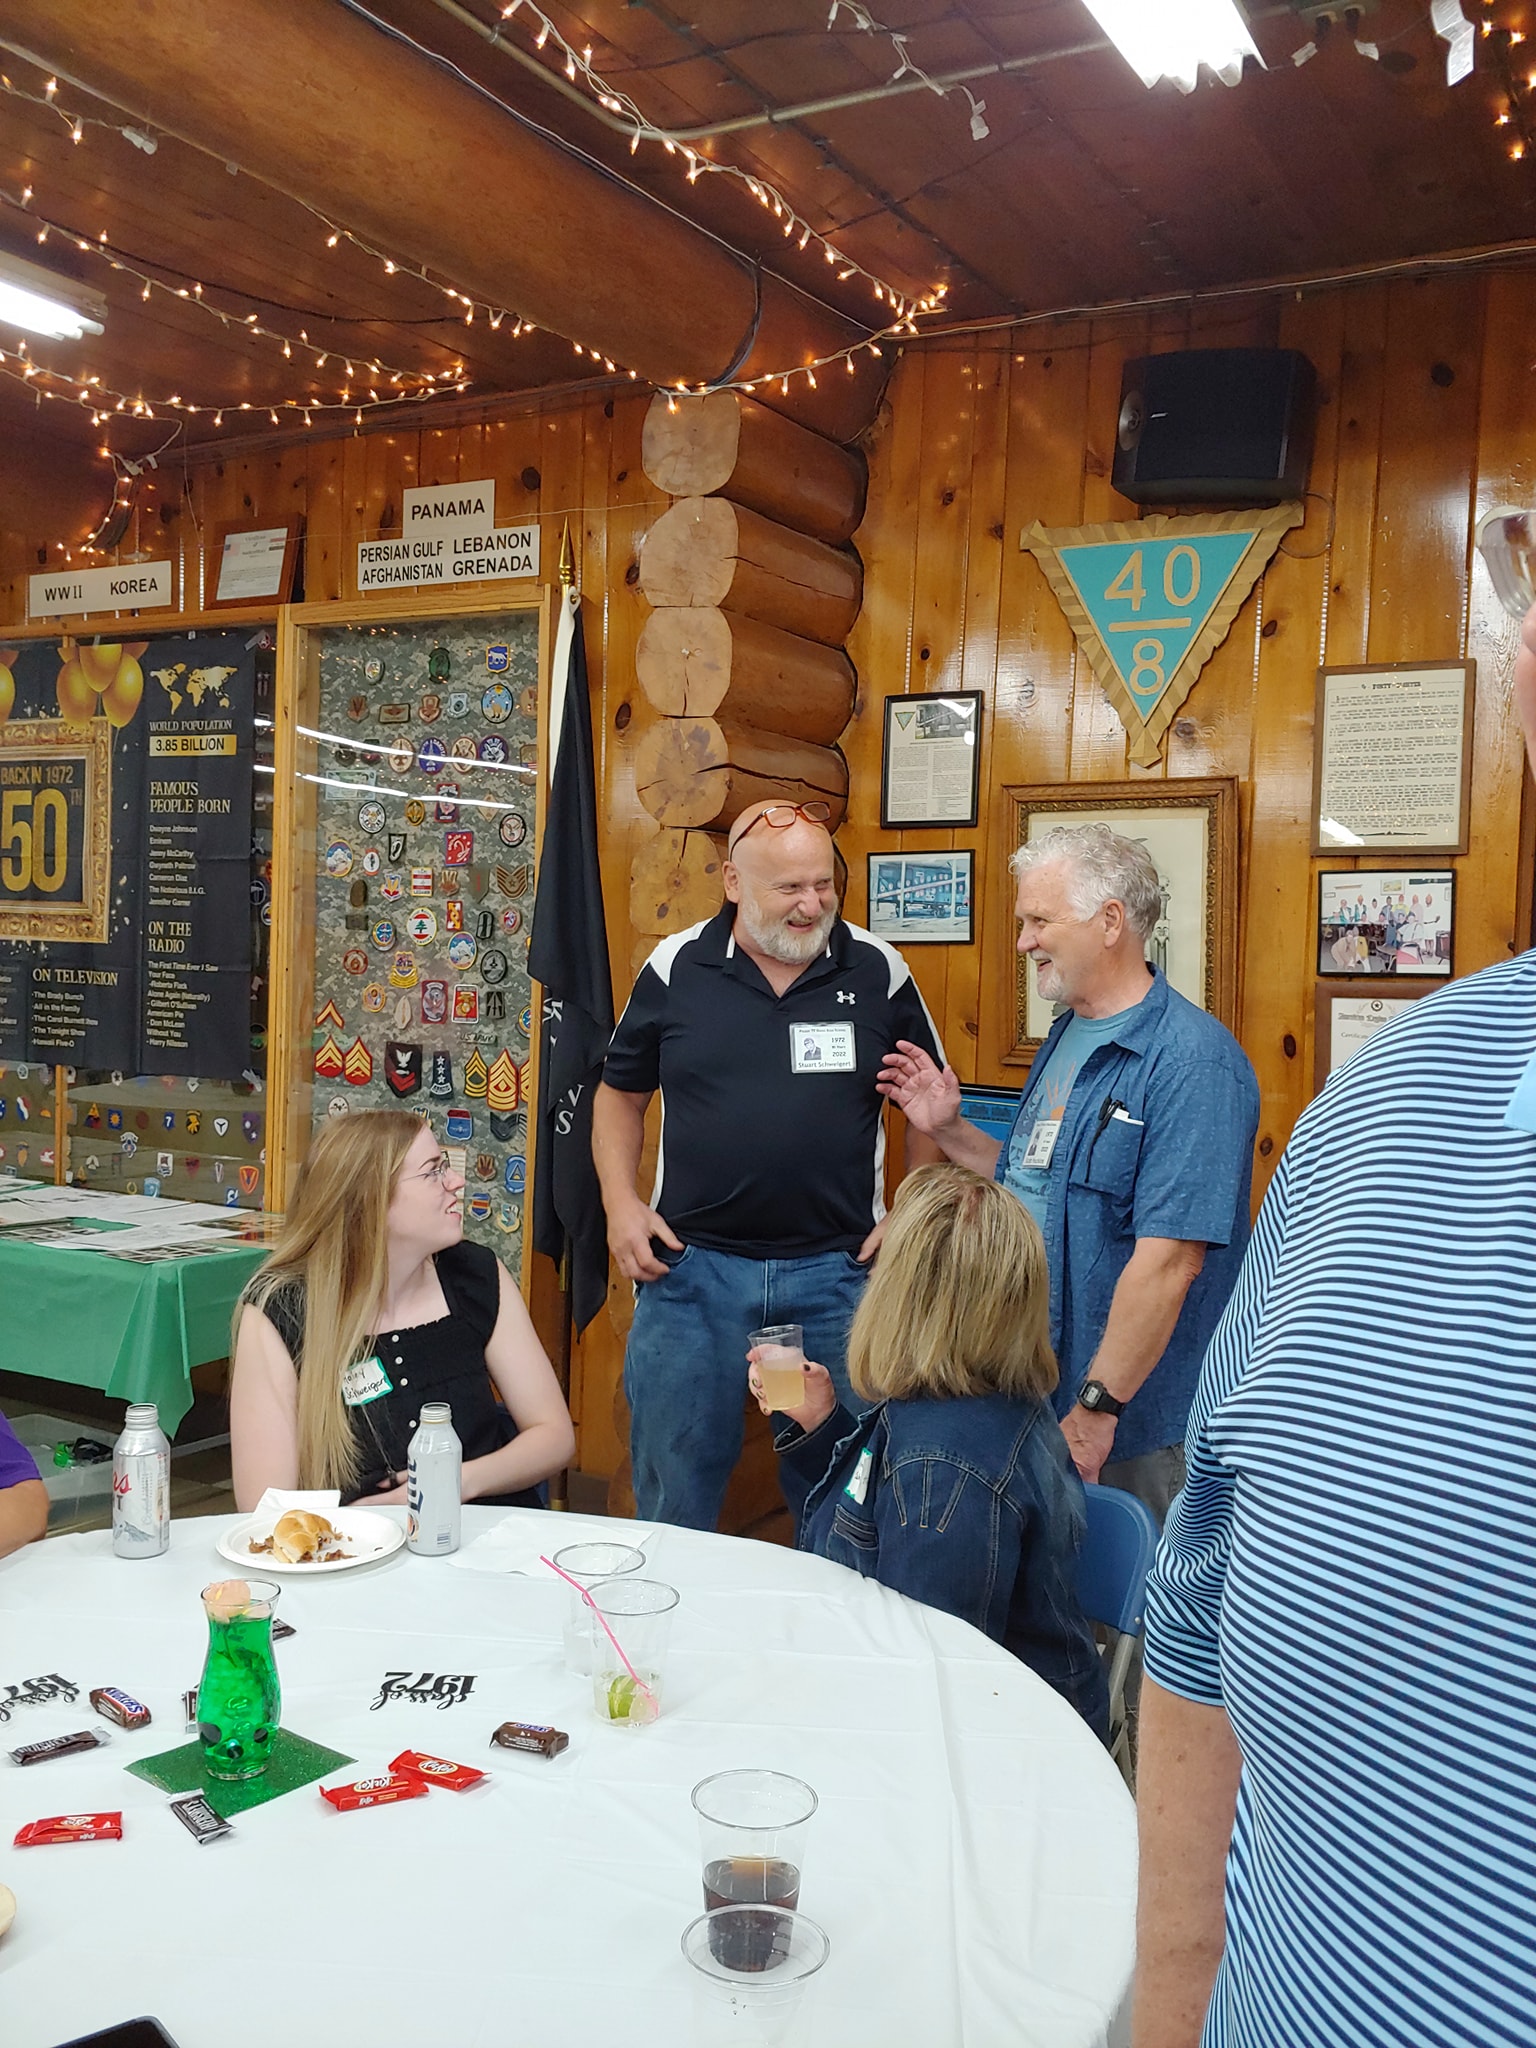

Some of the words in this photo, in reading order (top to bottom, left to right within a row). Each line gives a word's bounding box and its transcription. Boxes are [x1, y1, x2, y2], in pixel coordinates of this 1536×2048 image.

[411, 498, 485, 521] PANAMA
[360, 542, 410, 563] PERSIAN
[413, 540, 443, 558] GULF
[453, 531, 532, 555] LEBANON
[362, 563, 443, 585] AFGHANISTAN
[452, 555, 533, 576] GRENADA
[1103, 544, 1201, 612] 40
[110, 577, 159, 596] KOREA
[1129, 637, 1165, 696] 8
[149, 720, 179, 732] WORLD
[181, 719, 233, 731] POPULATION
[155, 738, 178, 752] 3.85
[181, 737, 225, 752] BILLION
[1, 766, 30, 785] BACK
[31, 766, 42, 784] IN
[46, 765, 74, 784] 1972
[150, 781, 199, 796] FAMOUS
[150, 798, 194, 813] PEOPLE
[197, 798, 232, 814] BORN
[1, 788, 68, 893] 50
[148, 920, 164, 935] ON
[168, 921, 192, 937] THE
[147, 938, 185, 953] RADIO
[32, 968, 51, 982] ON
[54, 968, 119, 986] TELEVISION
[380, 1672, 478, 1696] 1972
